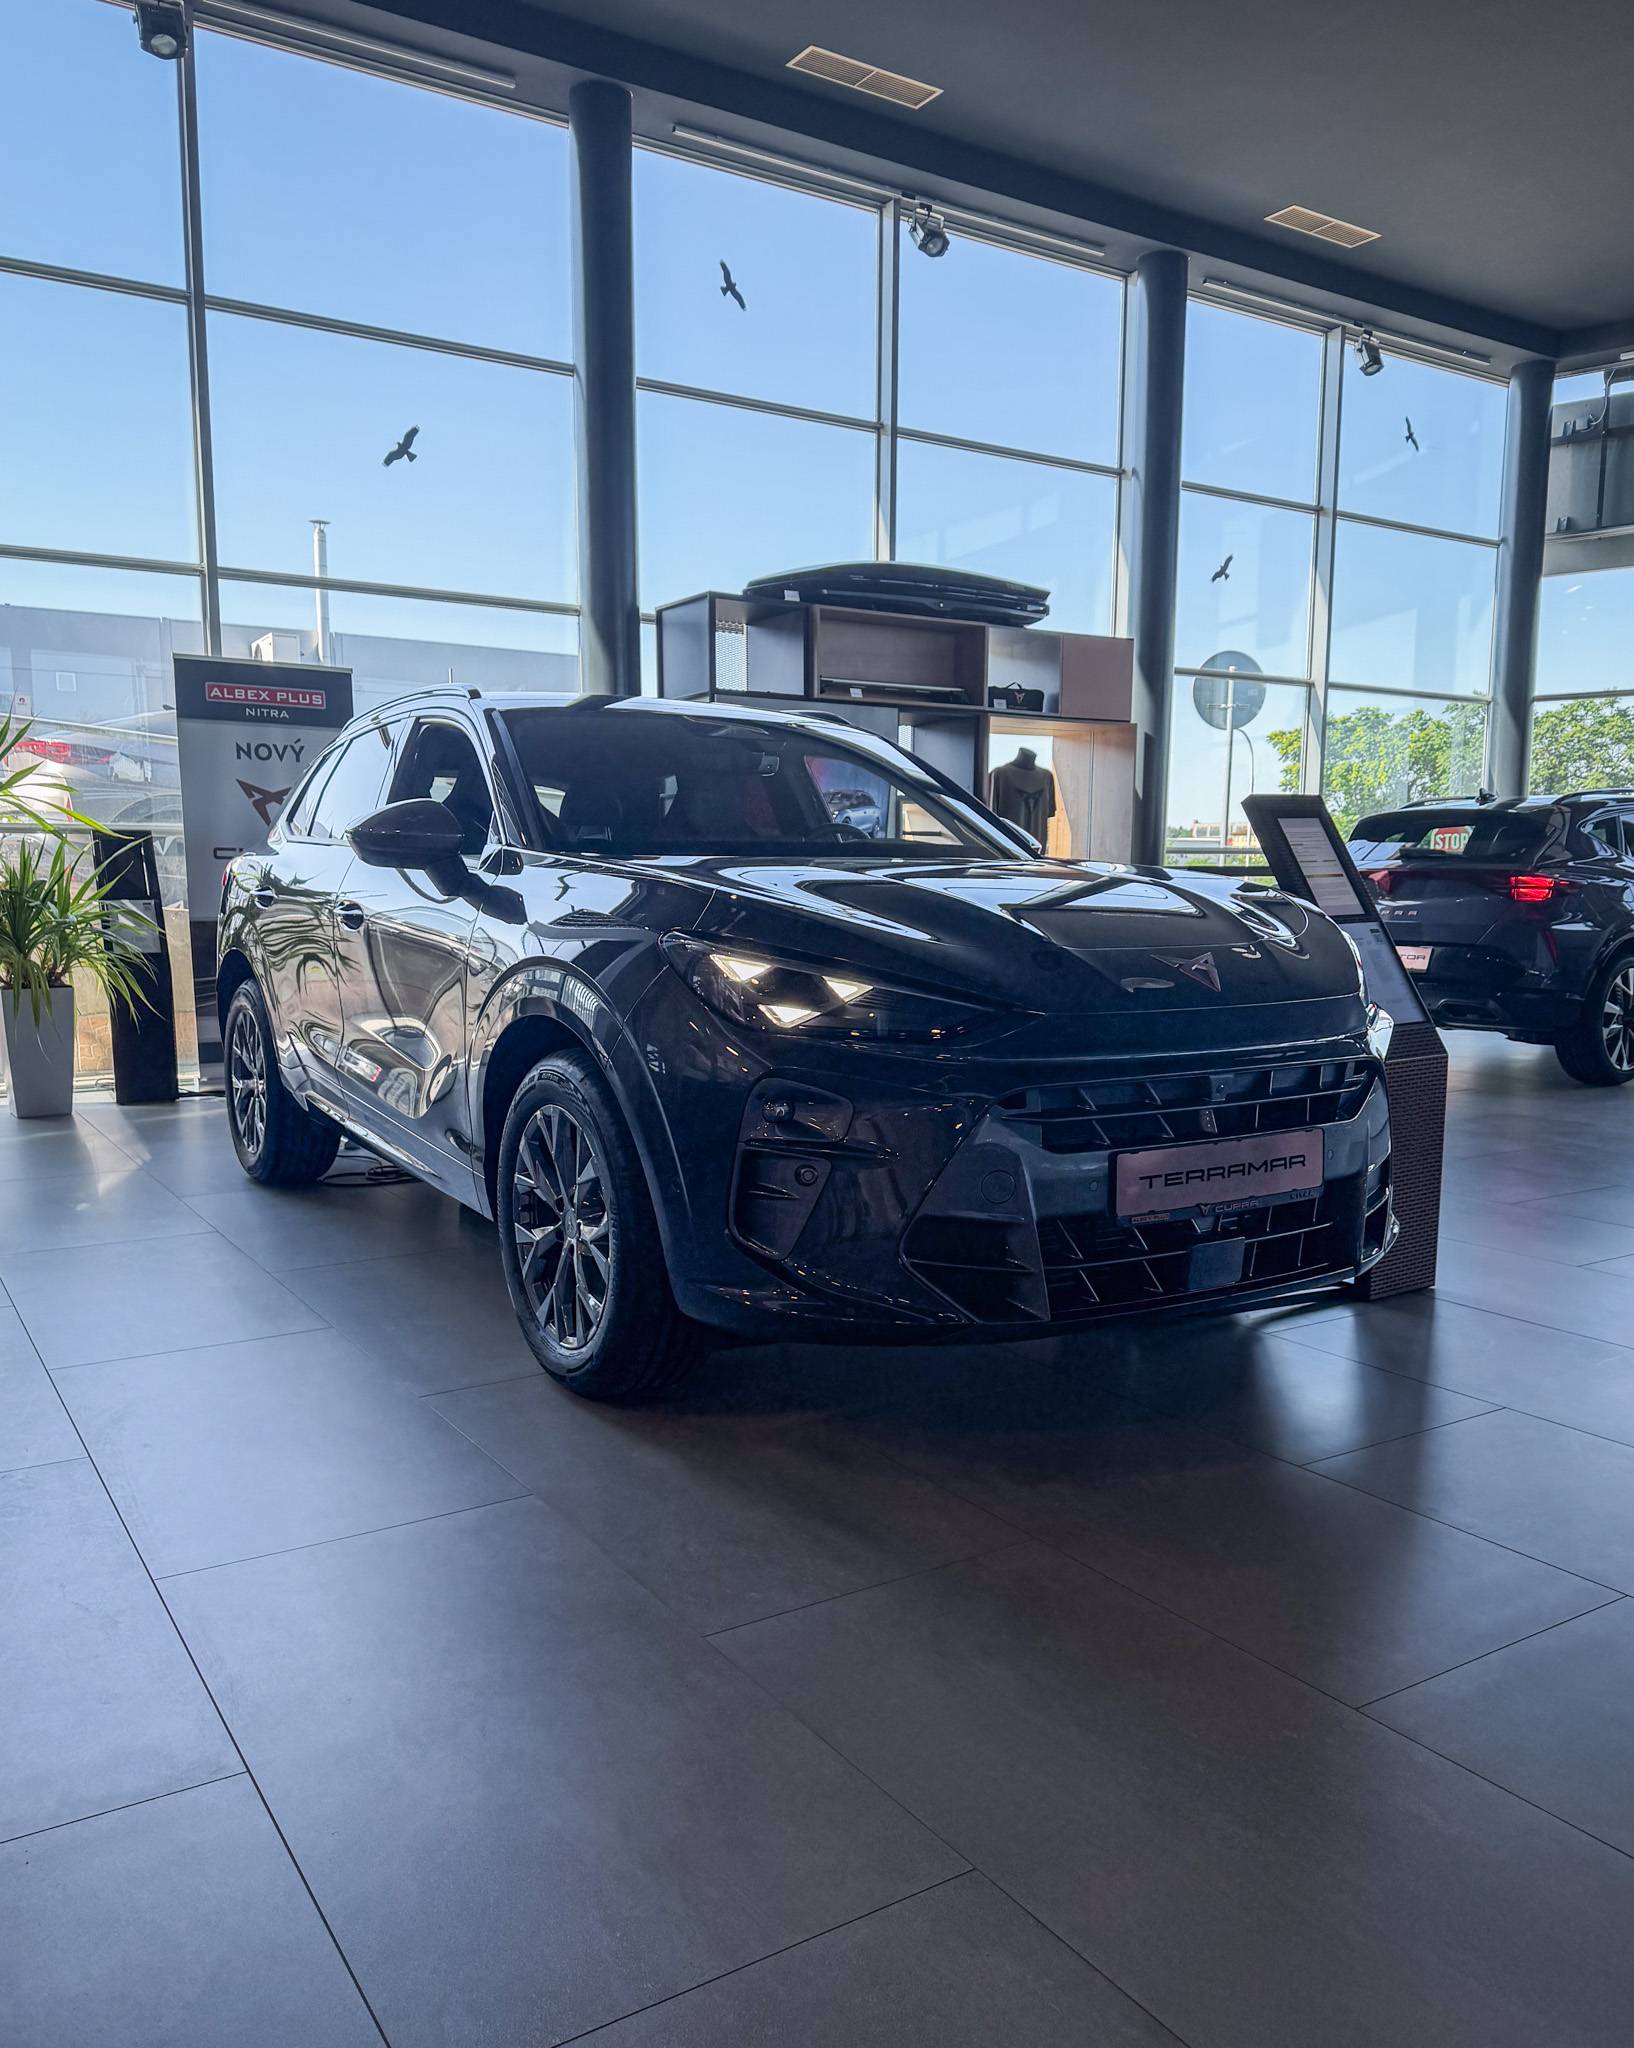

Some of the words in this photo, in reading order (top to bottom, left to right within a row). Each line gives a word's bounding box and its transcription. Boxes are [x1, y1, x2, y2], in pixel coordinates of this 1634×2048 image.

[210, 687, 270, 701] ALBEX
[276, 692, 323, 705] PLUS
[245, 707, 289, 719] NITRA
[235, 738, 304, 763] NOVÝ
[1435, 833, 1468, 850] STOP
[1139, 1154, 1306, 1189] TERRAMAR
[1215, 1200, 1259, 1213] CUPRA
